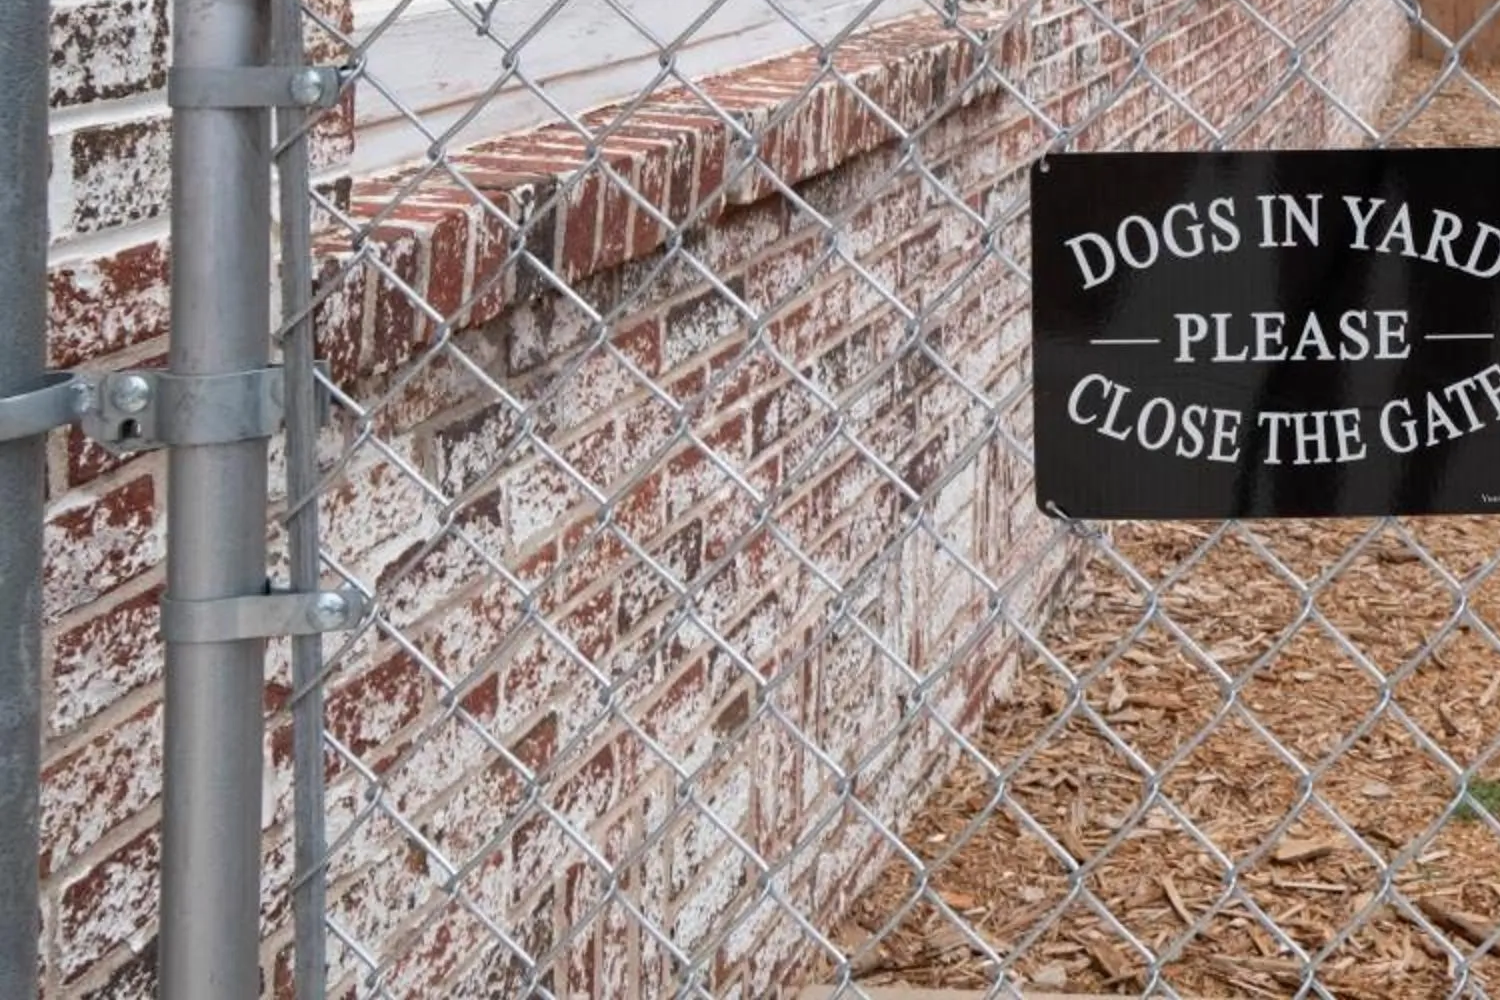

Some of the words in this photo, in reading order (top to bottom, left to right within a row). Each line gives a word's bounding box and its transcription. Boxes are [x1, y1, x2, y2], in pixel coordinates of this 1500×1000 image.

[1064, 197, 1241, 290] DOGS
[1256, 194, 1323, 248] IN
[1173, 310, 1411, 363] PLEASE
[1067, 373, 1242, 464] CLOSE
[1257, 408, 1367, 465] THE
